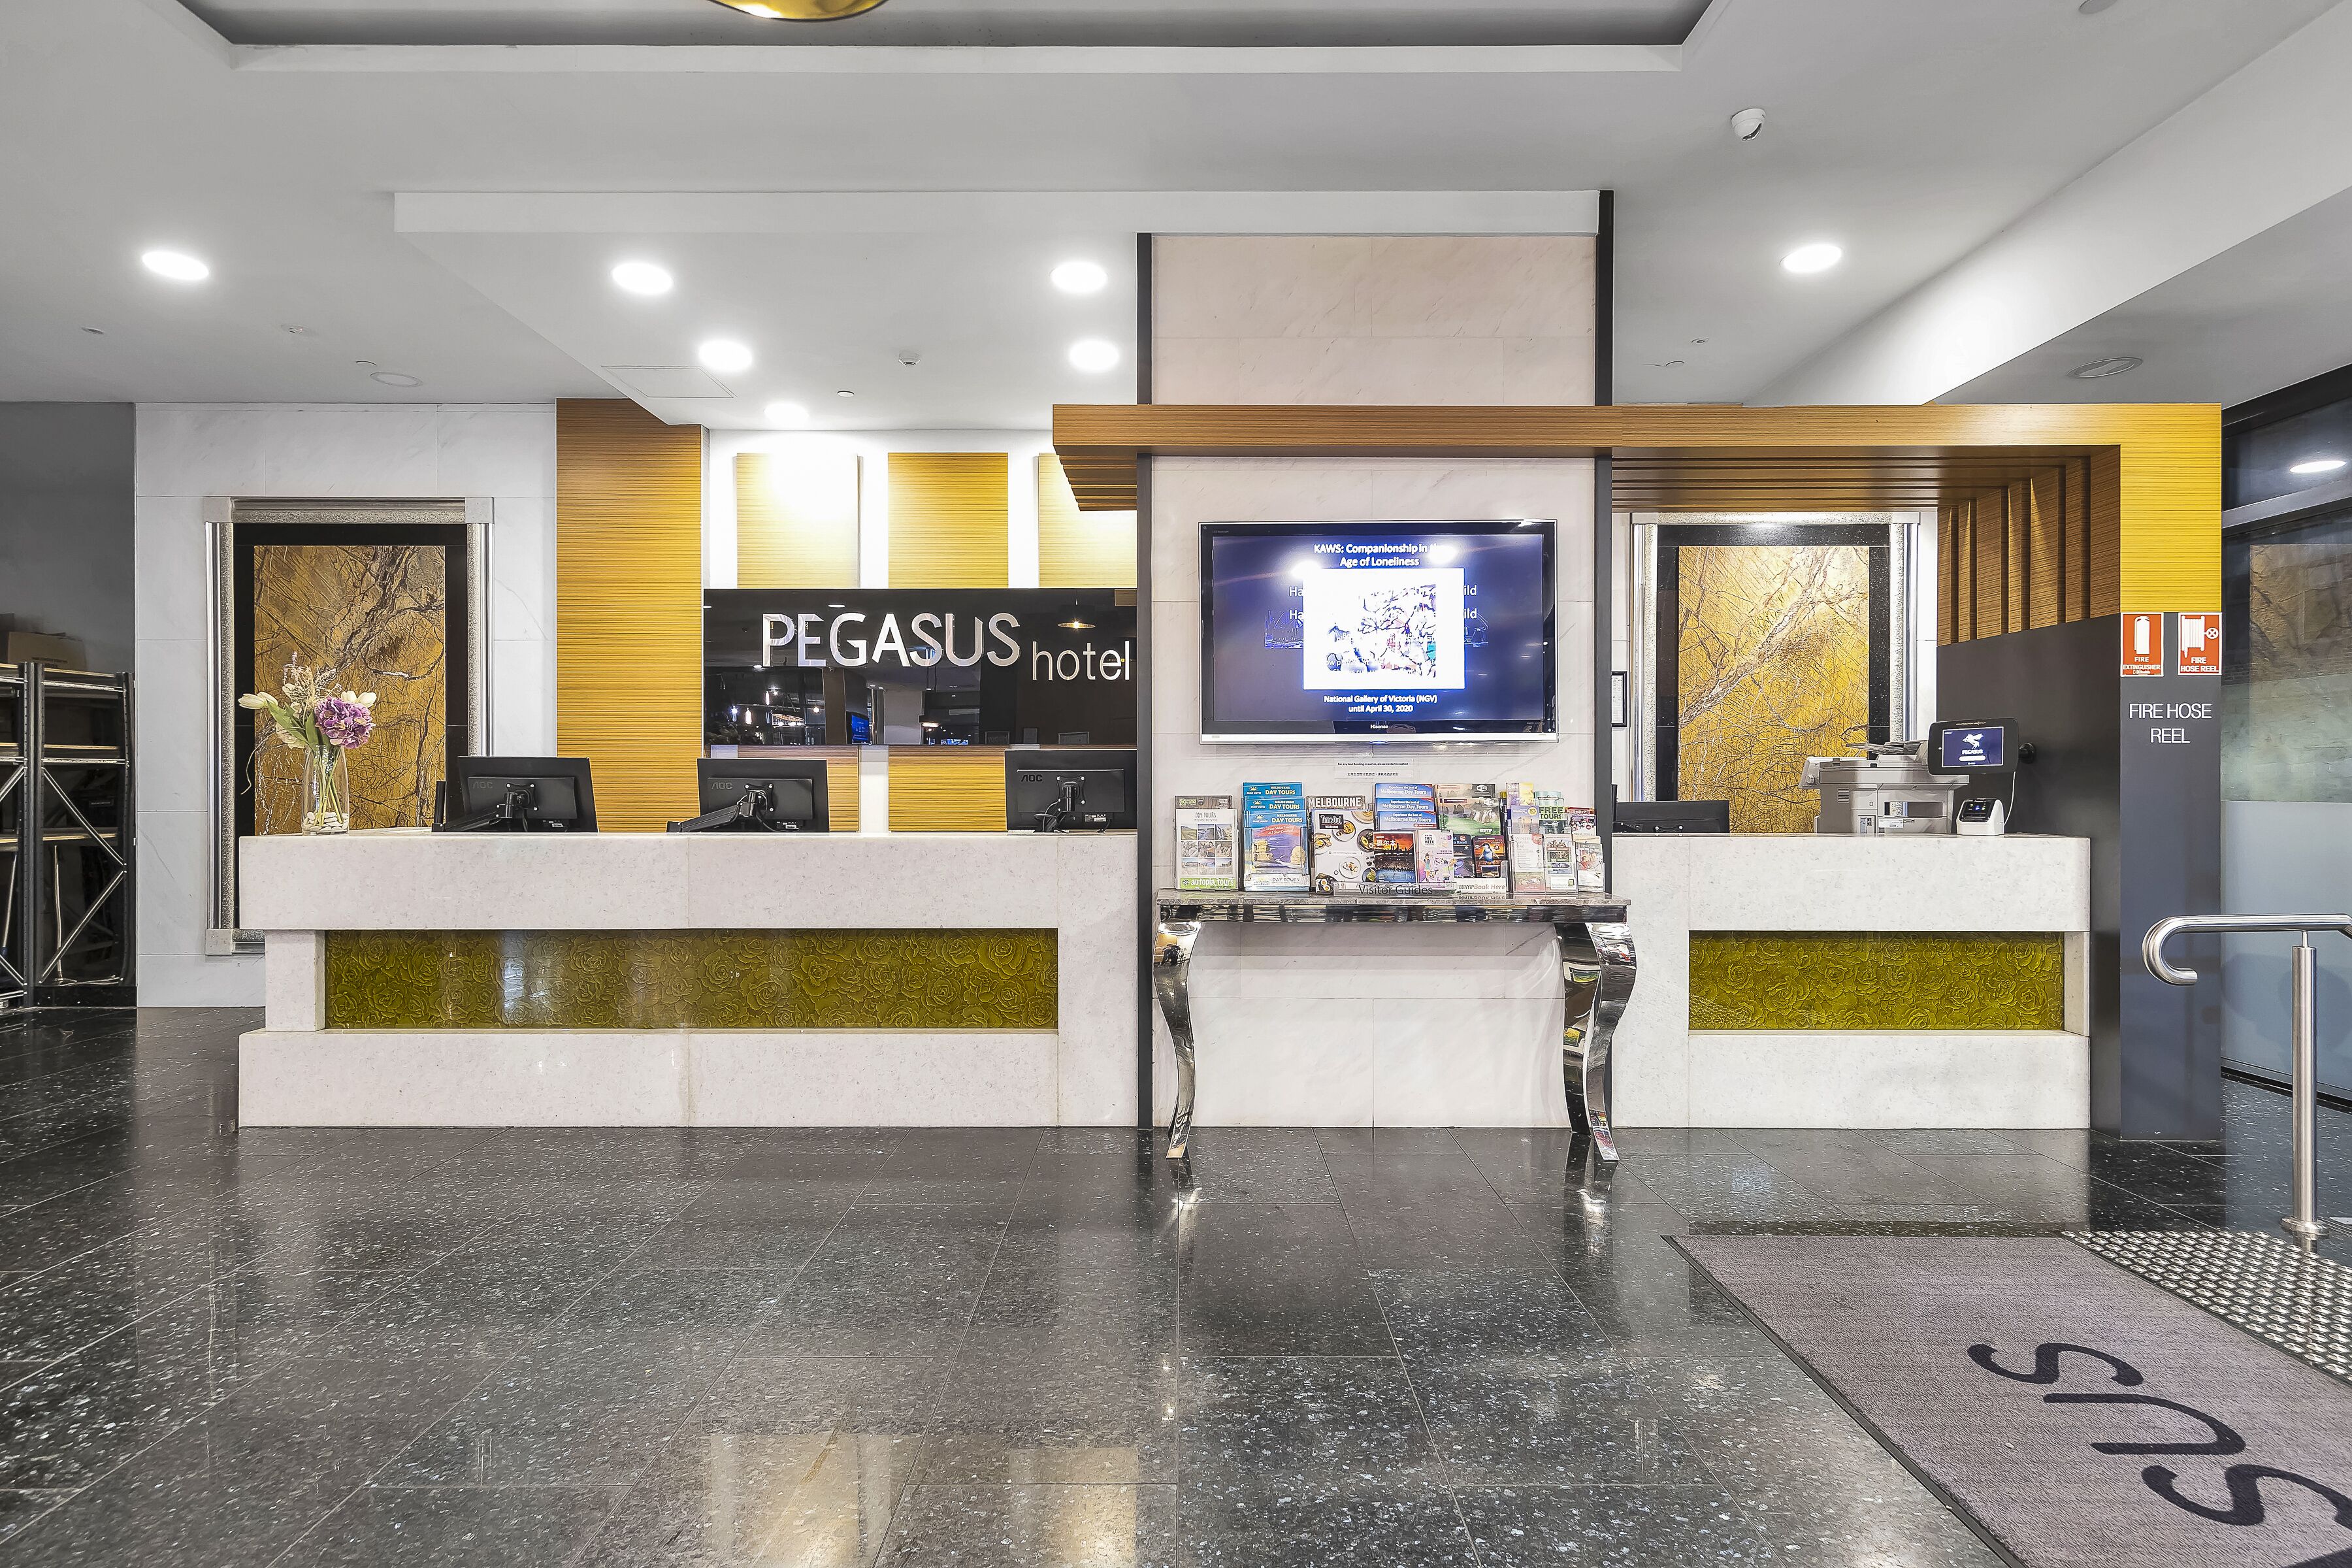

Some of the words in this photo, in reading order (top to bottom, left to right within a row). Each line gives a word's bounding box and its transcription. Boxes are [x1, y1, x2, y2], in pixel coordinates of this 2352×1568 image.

[1313, 544, 1345, 554] KAWS:
[1345, 543, 1419, 555] Companionship
[1420, 544, 1428, 553] in
[1339, 558, 1358, 568] Age
[1360, 557, 1370, 566] of
[1371, 557, 1420, 566] Loneliness
[761, 612, 1021, 667] PEGASUS
[1032, 640, 1130, 681] hotel
[1354, 694, 1379, 705] Gallery
[1380, 694, 1388, 703] of
[1388, 694, 1416, 703] Victoria
[1416, 694, 1438, 704] (NGV)
[1348, 704, 1365, 713] until
[1365, 704, 1382, 714] April
[1382, 704, 1394, 713] 30,
[1395, 704, 1414, 713] 2020
[2129, 703, 2164, 719] FIRE
[2166, 703, 2212, 719] HOSE
[2149, 728, 2191, 743] REEL
[473, 781, 493, 789] AOC
[1308, 797, 1362, 808] MELBOURNE
[1359, 885, 1394, 894] Visitor
[1396, 885, 1433, 895] Guides
[1967, 1342, 2352, 1568] SUS
